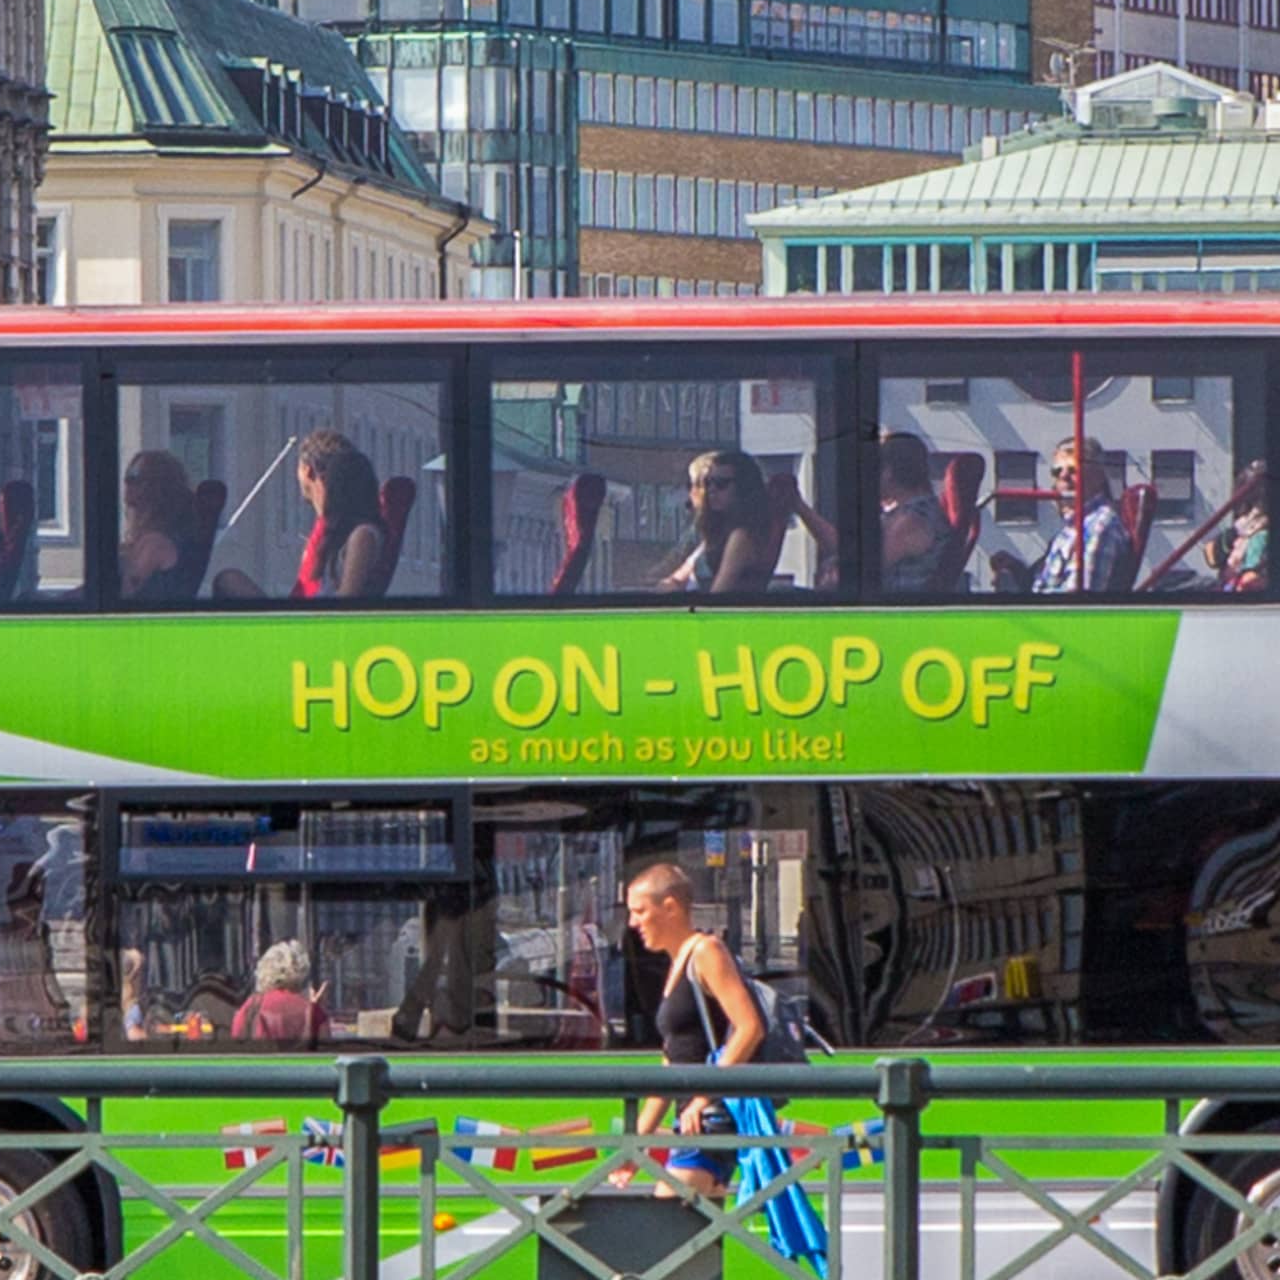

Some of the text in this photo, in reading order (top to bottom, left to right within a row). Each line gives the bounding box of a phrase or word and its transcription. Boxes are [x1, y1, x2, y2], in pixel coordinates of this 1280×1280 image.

[291, 645, 473, 730] HOP
[493, 644, 621, 728] ON
[697, 636, 882, 718] HOP
[901, 642, 1062, 726] OFF
[470, 730, 845, 767] as much as you like!
